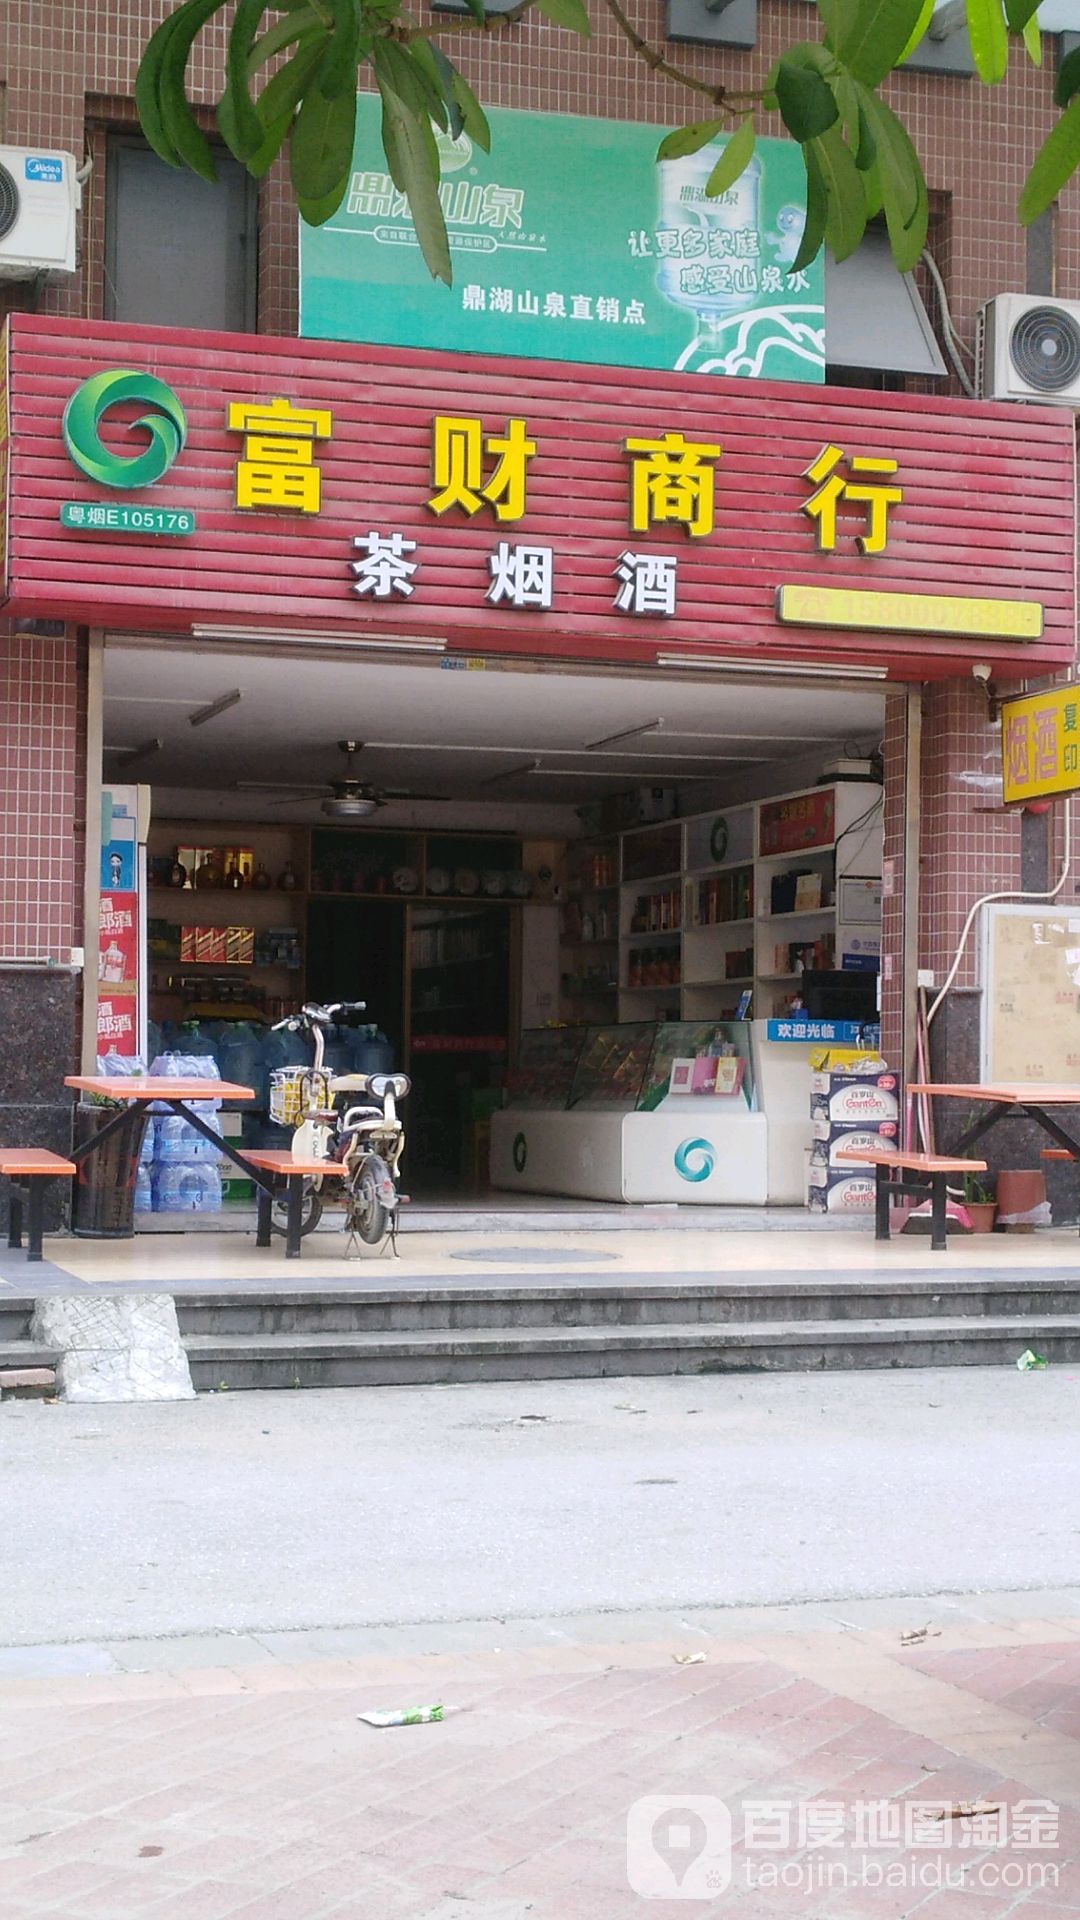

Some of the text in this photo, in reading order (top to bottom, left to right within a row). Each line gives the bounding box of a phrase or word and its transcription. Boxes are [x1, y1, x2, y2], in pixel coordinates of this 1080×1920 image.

[346, 171, 525, 229] 鼎山泉
[628, 228, 761, 260] 让更多家庭
[679, 264, 811, 295] 感受山泉水
[461, 285, 647, 326] 鼎湖山泉直销点
[227, 398, 904, 556] 富财商行
[68, 506, 189, 530] 粤烟E105176
[350, 531, 678, 617] 茶烟酒
[1006, 707, 1058, 788] 烟酒
[1063, 703, 1078, 772] 复印
[97, 1014, 132, 1034] 郎酒
[777, 1023, 836, 1039] 欢迎光临
